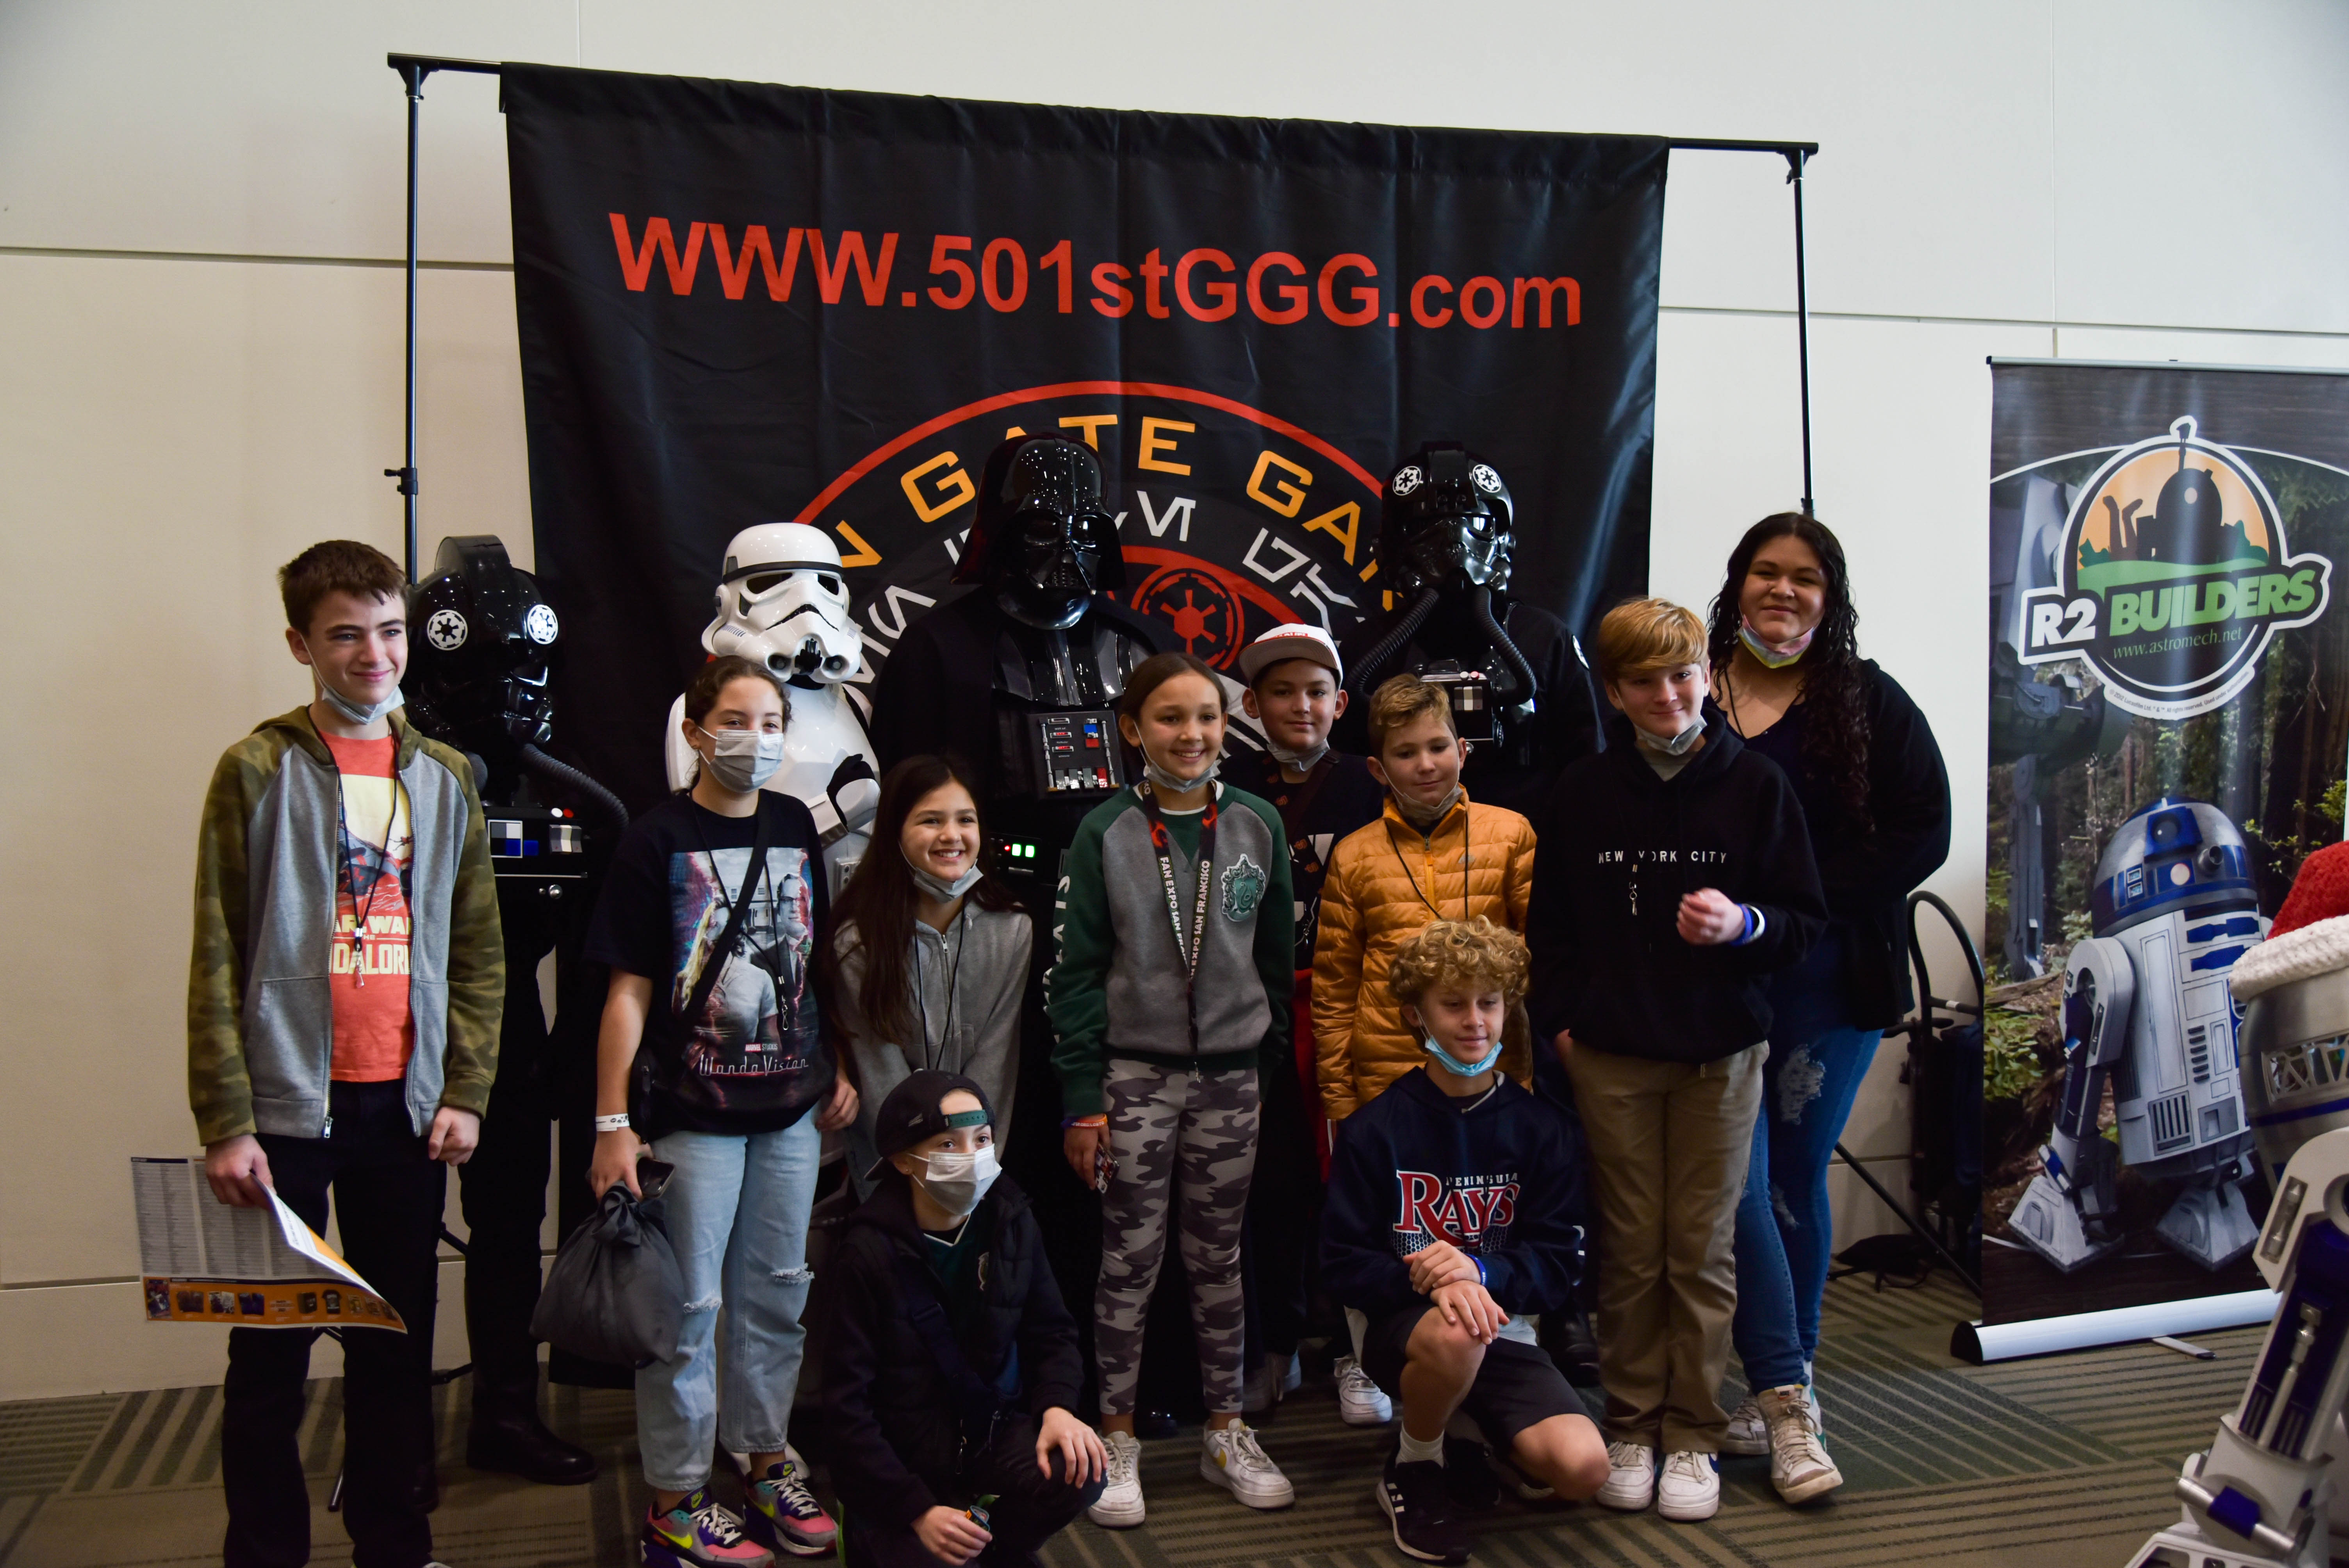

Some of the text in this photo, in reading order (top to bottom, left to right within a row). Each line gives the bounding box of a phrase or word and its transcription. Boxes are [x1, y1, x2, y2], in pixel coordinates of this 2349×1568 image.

[901, 414, 1195, 522] GTE
[2031, 569, 2316, 647] R2 BUILDERS
[2113, 627, 2242, 659] www.astromech.net
[2124, 697, 2144, 709] Lucasfilm
[2204, 697, 2215, 705] Used
[1160, 857, 1172, 878] FAN
[1599, 850, 1623, 864] NEW
[1691, 851, 1727, 864] CITY
[1165, 880, 1178, 909] EXPO
[1196, 860, 1210, 913] FRANCISCO
[1172, 911, 1181, 931] SAN
[1194, 916, 1203, 935] SAN
[1191, 937, 1200, 966] EXPO
[1446, 1172, 1518, 1187] PENINSULA
[1393, 1169, 1520, 1248] RAYS
